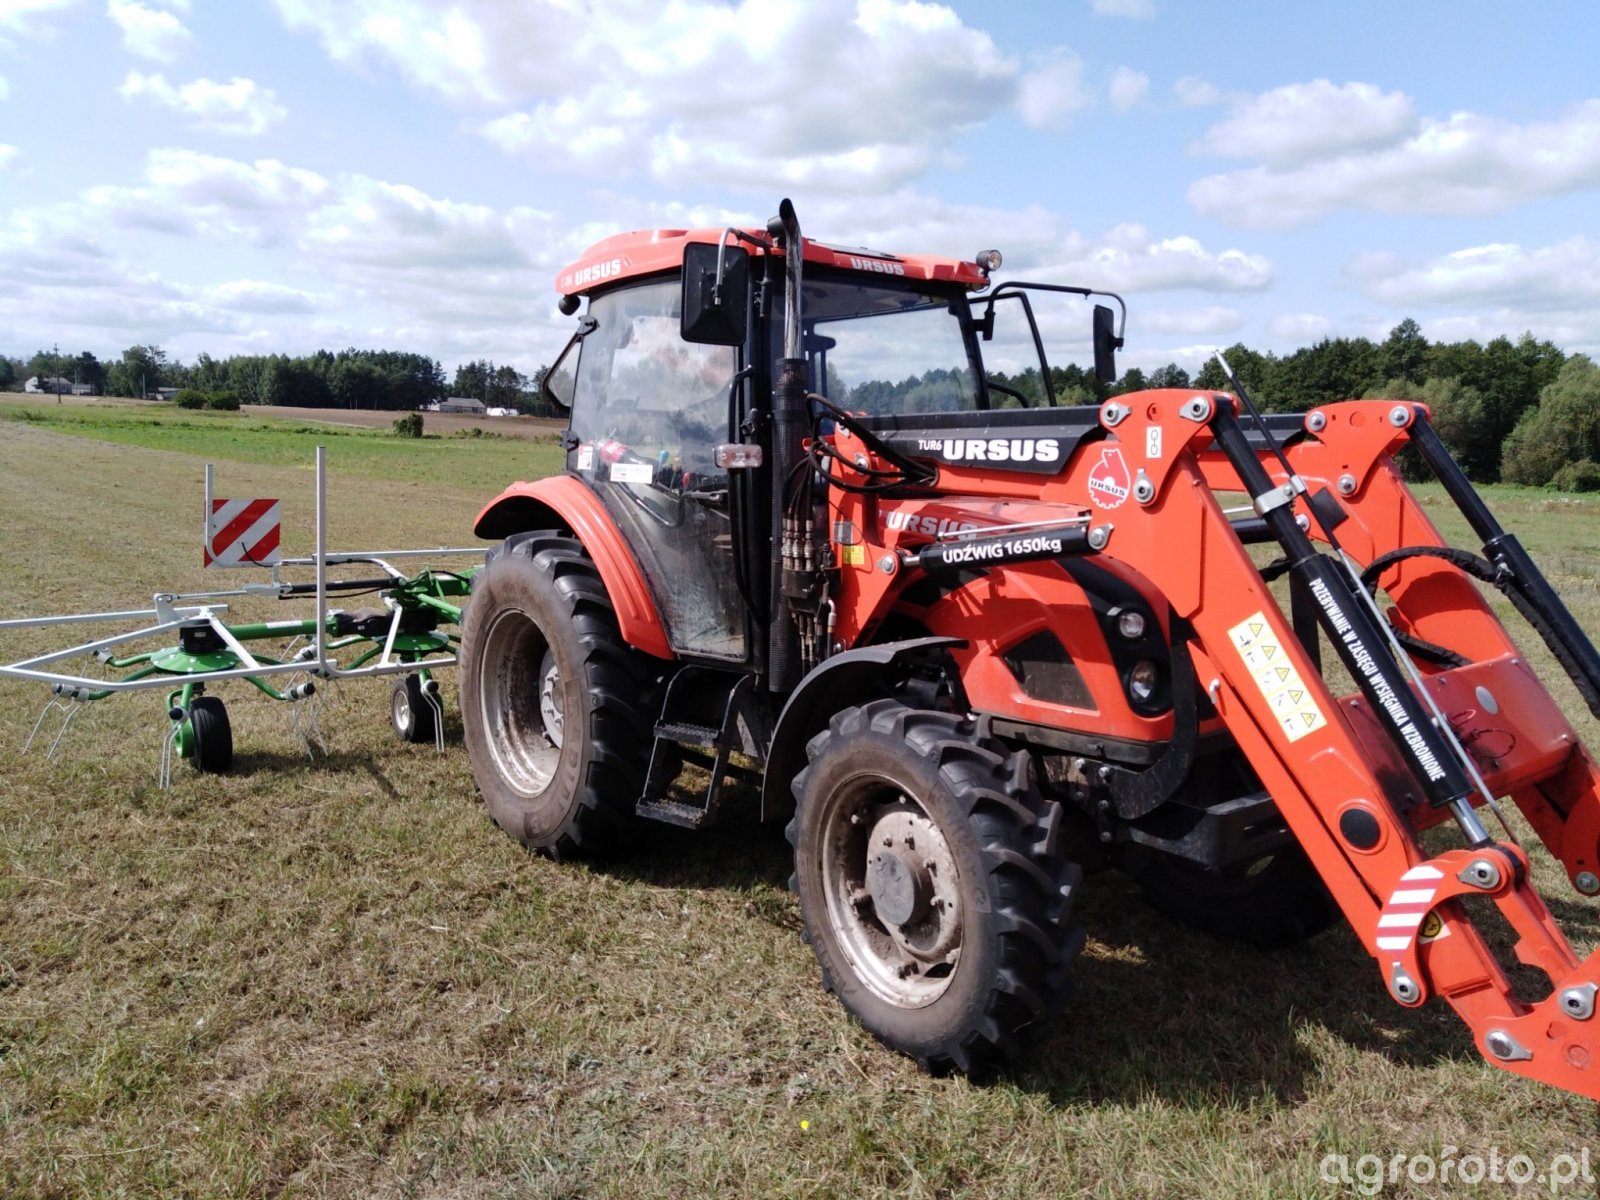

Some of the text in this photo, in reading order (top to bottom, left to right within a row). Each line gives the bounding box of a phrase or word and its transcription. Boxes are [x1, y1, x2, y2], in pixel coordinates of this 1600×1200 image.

[575, 258, 621, 286] URSUS
[850, 257, 904, 275] URSUS
[918, 439, 1059, 461] TUR6 URSUS
[1090, 480, 1126, 497] URSUS
[886, 509, 977, 541] URSUS
[943, 536, 1062, 564] UDŹWIG 1650kg
[1309, 578, 1447, 782] PRZEBYWANIE W ZASIĘGU WYSIĘGNIKA WZBRONIONE
